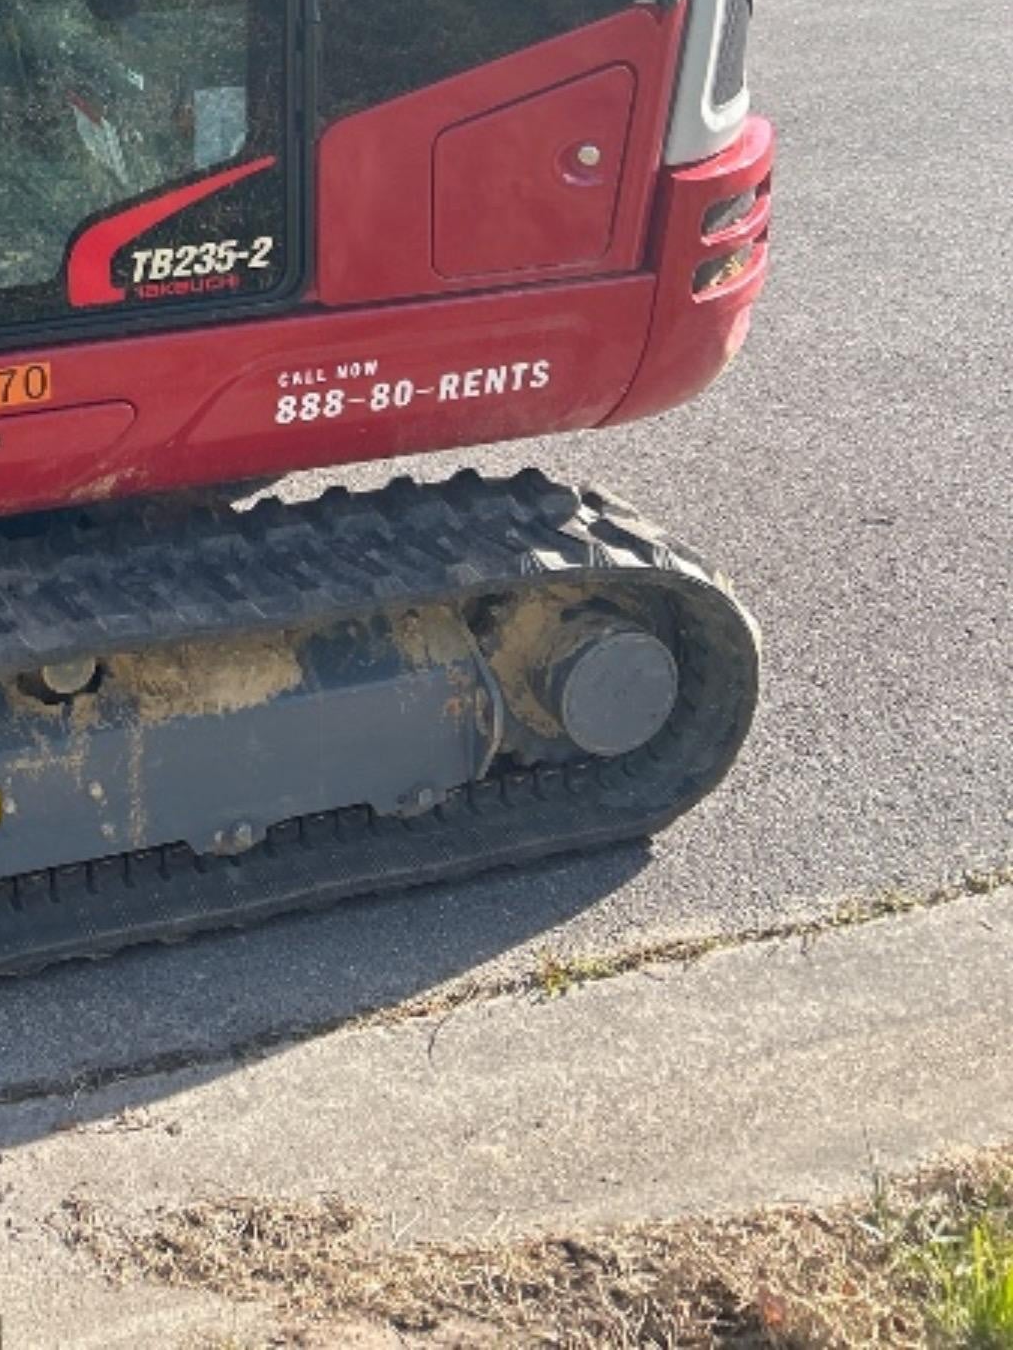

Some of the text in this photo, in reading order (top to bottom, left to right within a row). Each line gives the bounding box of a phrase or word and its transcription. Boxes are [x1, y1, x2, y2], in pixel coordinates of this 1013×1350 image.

[131, 236, 274, 284] TB235-2
[274, 359, 551, 424] 888-80-RENTS
[277, 359, 378, 388] CALL NOW
